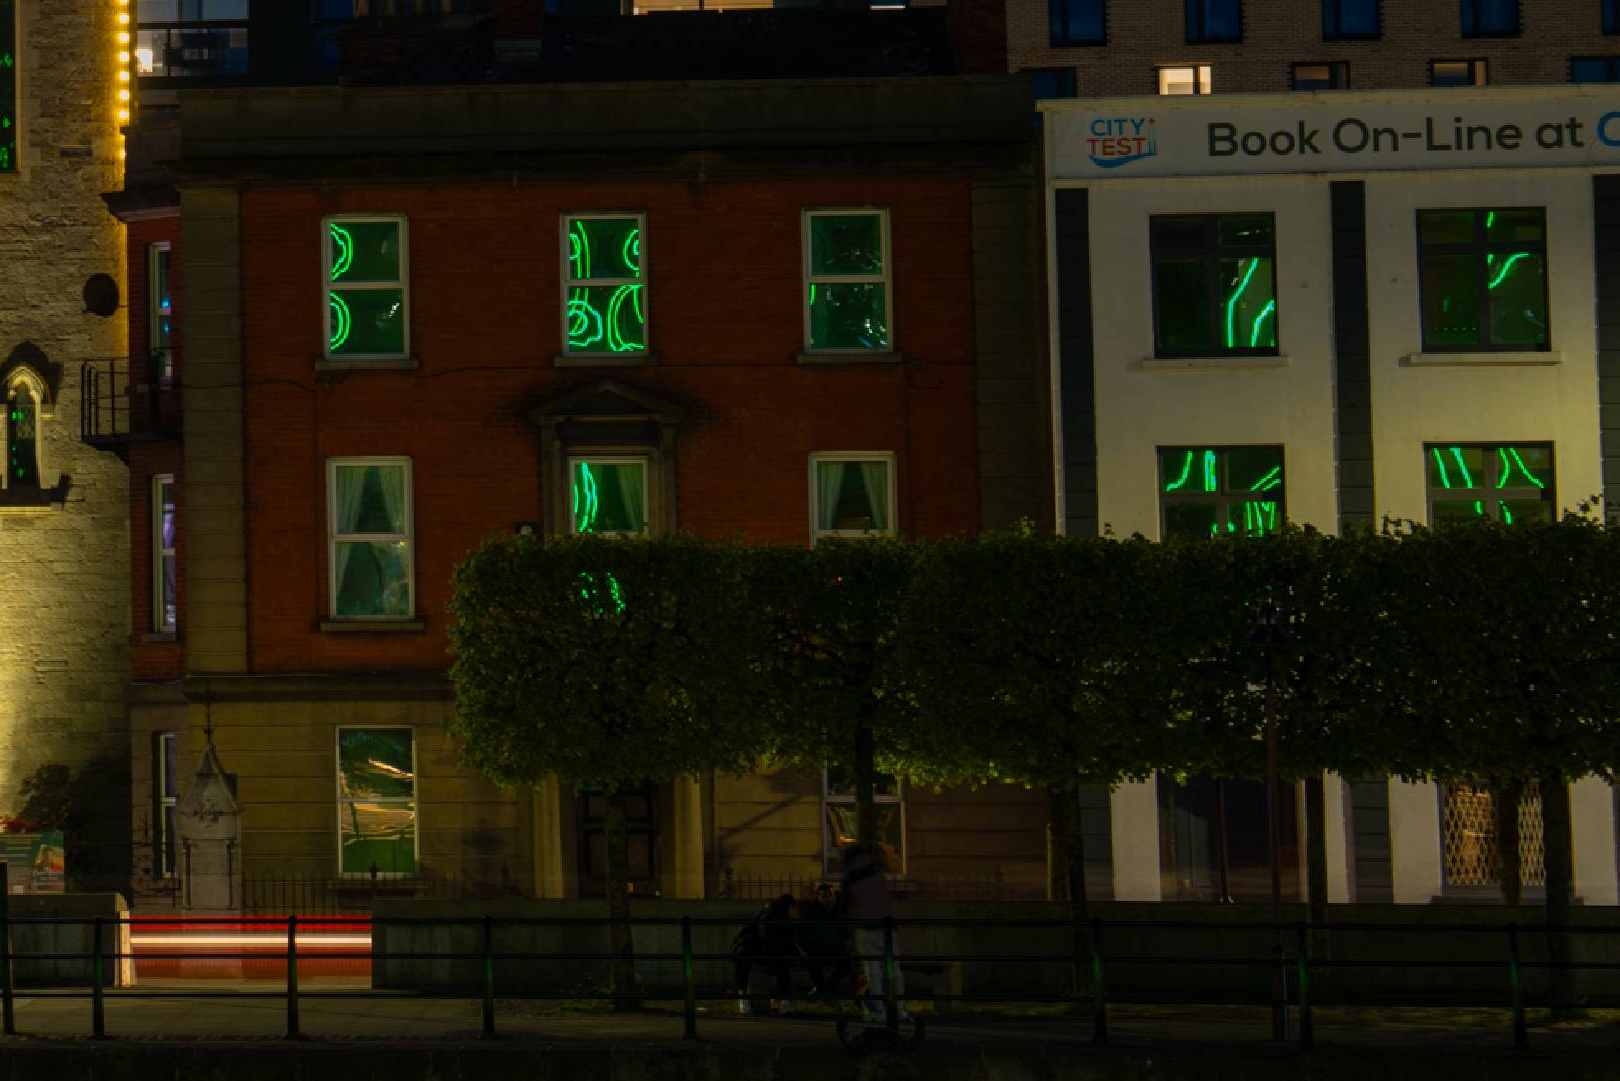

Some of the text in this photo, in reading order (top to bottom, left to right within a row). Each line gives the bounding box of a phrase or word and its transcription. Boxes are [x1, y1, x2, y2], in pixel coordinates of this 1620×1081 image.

[1090, 118, 1145, 137] CITY
[1208, 120, 1322, 156] Book
[1333, 117, 1522, 153] On-Line
[1536, 117, 1584, 149] at
[1086, 137, 1146, 156] TEST
